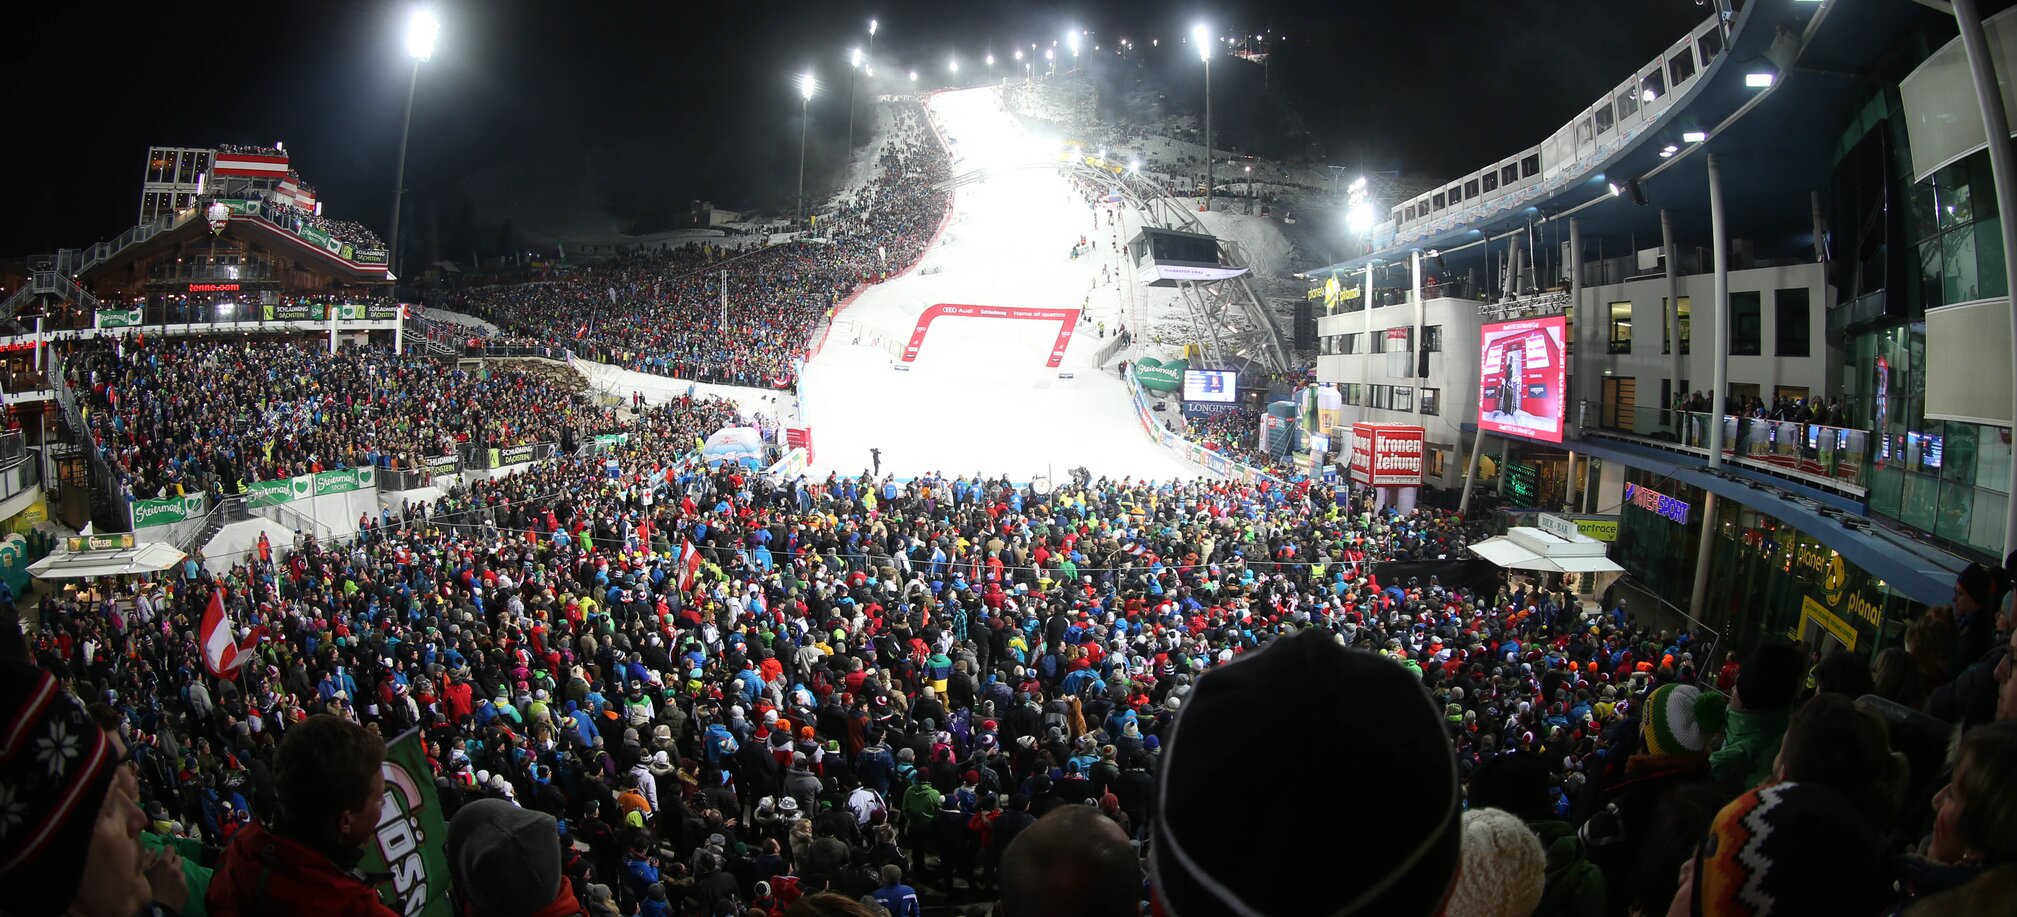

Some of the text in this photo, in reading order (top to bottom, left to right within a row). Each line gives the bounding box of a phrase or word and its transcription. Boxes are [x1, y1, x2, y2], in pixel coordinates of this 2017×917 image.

[189, 283, 240, 292] tenne.com
[276, 305, 309, 313] SCHLADMING
[1137, 363, 1180, 380] Steiermark
[1377, 435, 1421, 453] Kronen
[1376, 452, 1420, 472] Zeitung
[317, 474, 358, 491] Steiermark
[135, 503, 185, 523] Steiermark
[1633, 484, 1690, 525] INTERSPORT
[1796, 545, 1825, 573] planet
[1847, 589, 1883, 627] planai
